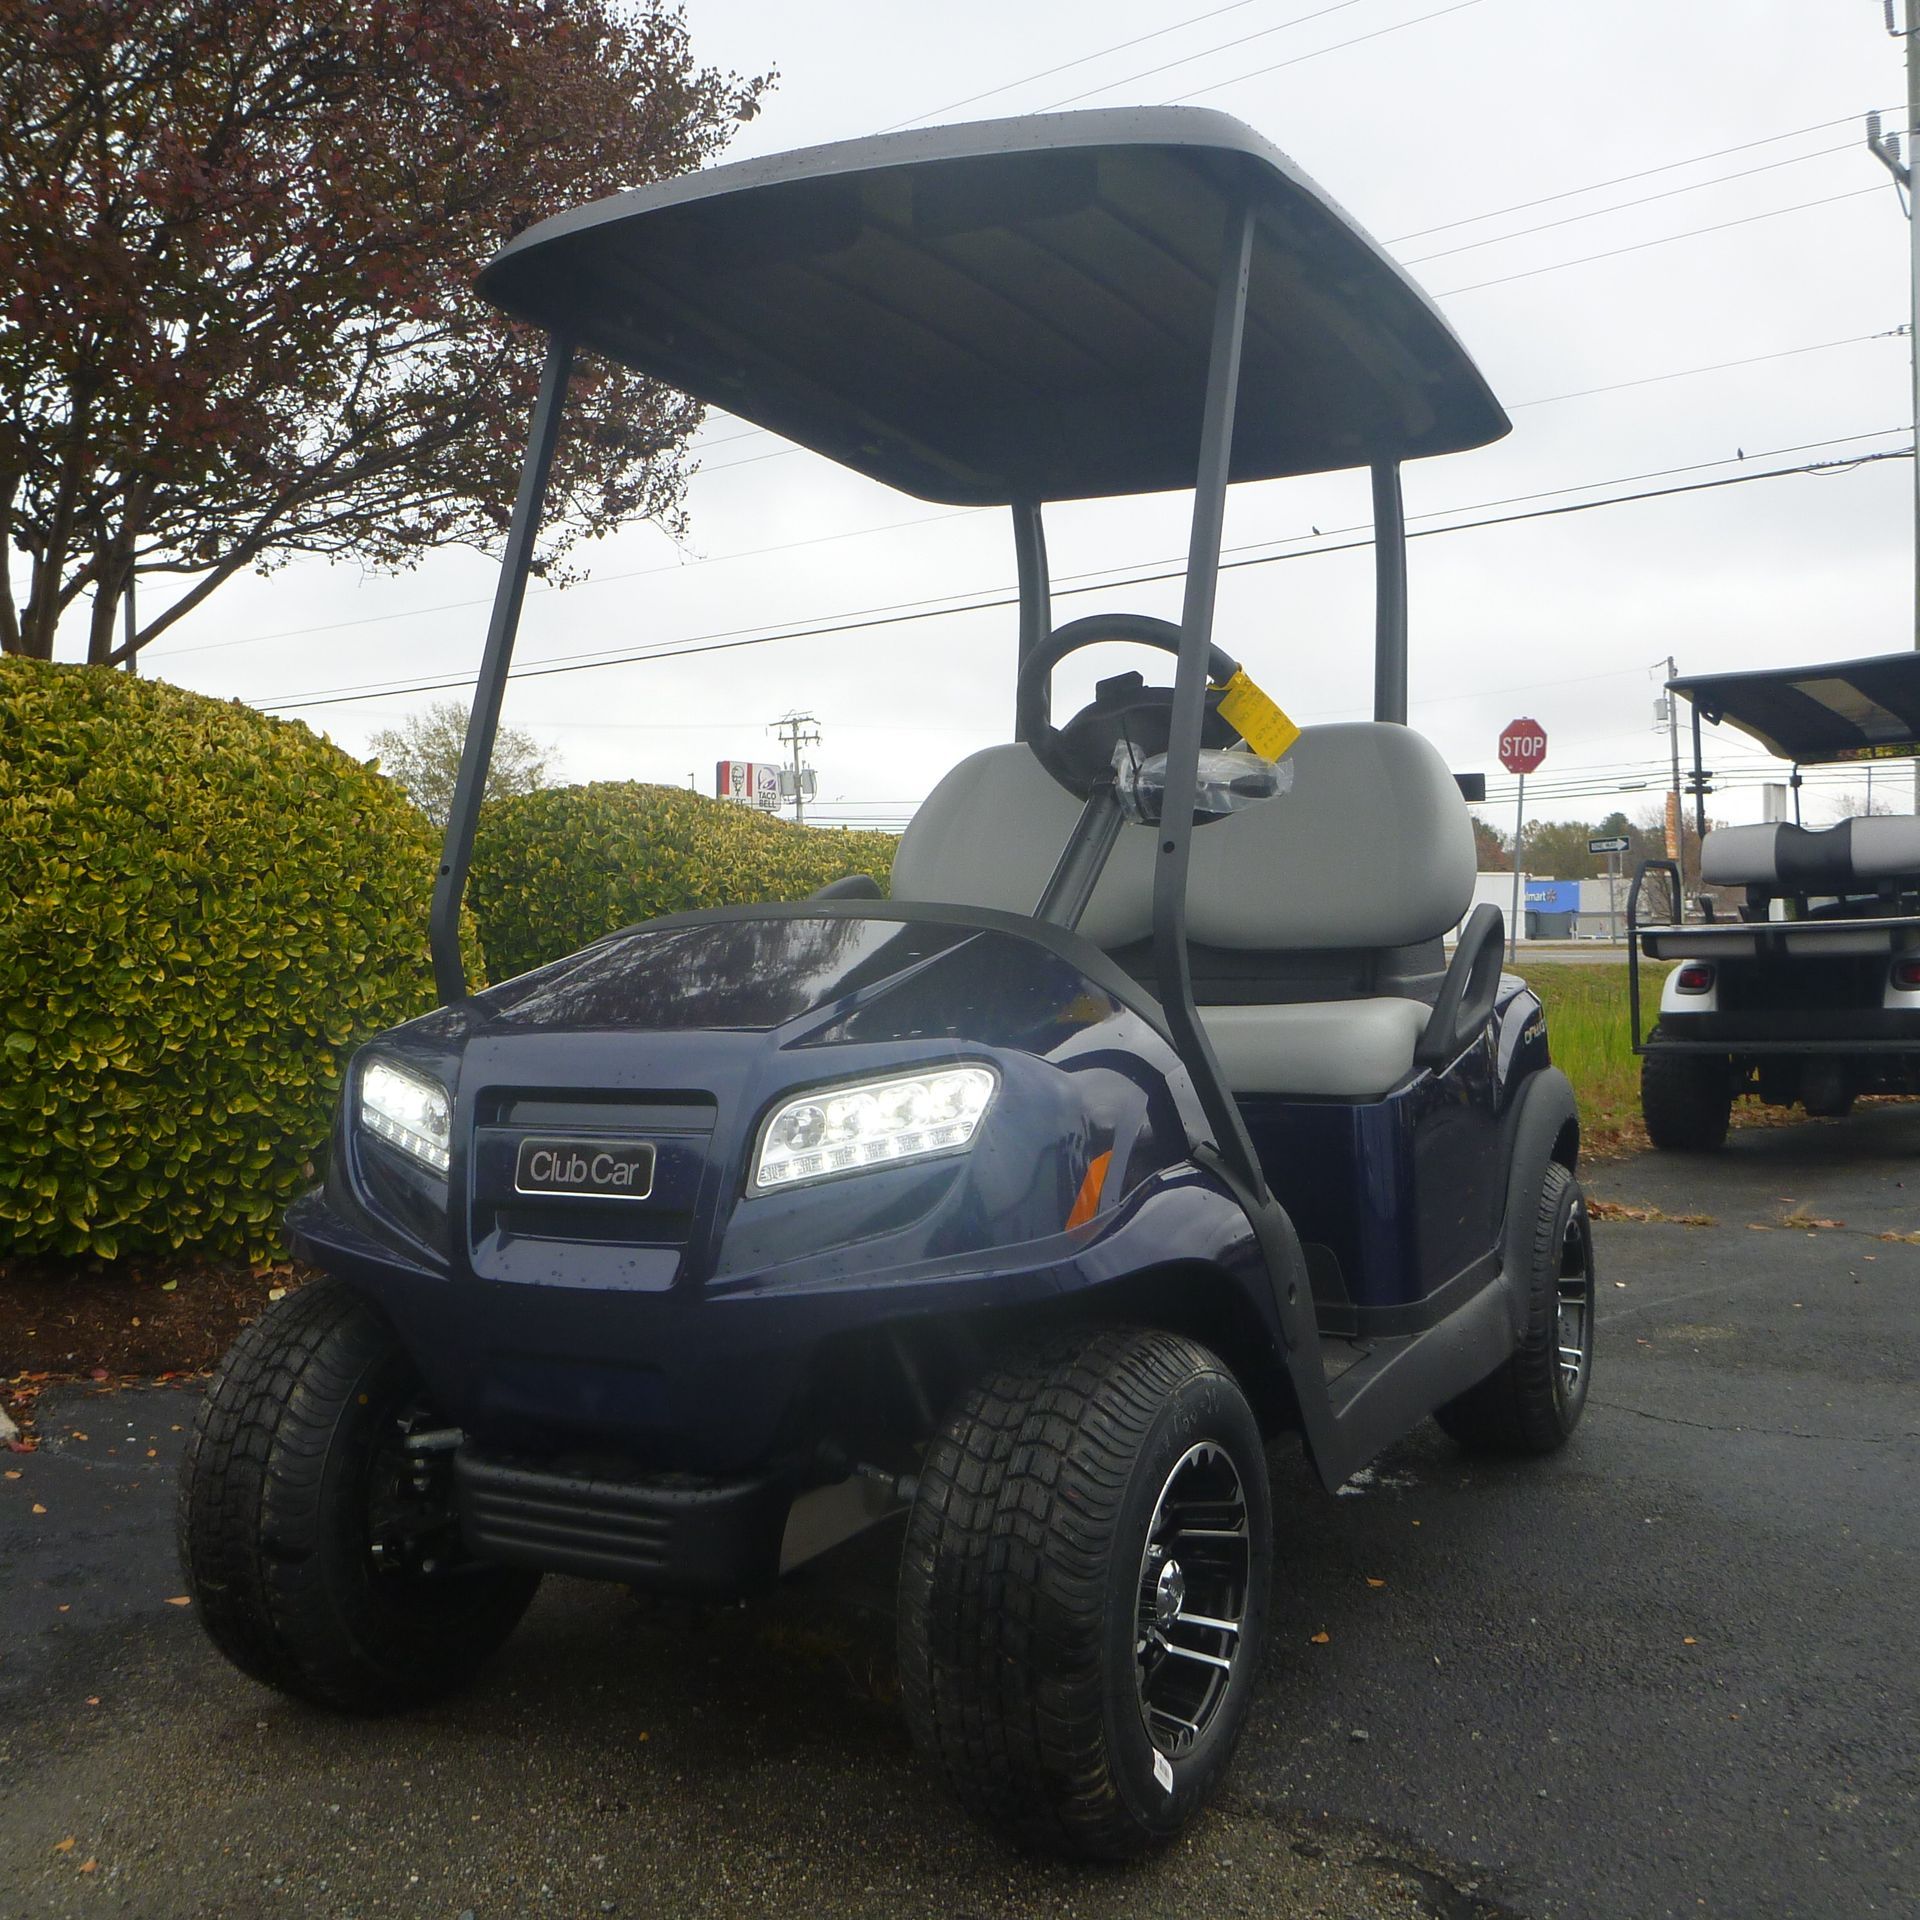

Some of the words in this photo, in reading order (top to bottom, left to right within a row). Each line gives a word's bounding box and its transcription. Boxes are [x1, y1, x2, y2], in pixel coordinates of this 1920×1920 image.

[1501, 736, 1544, 757] STOP
[758, 791, 777, 800] TACO
[758, 799, 777, 809] BELL
[1525, 891, 1547, 902] lmart
[530, 1151, 588, 1184] Club
[591, 1153, 640, 1186] Car
